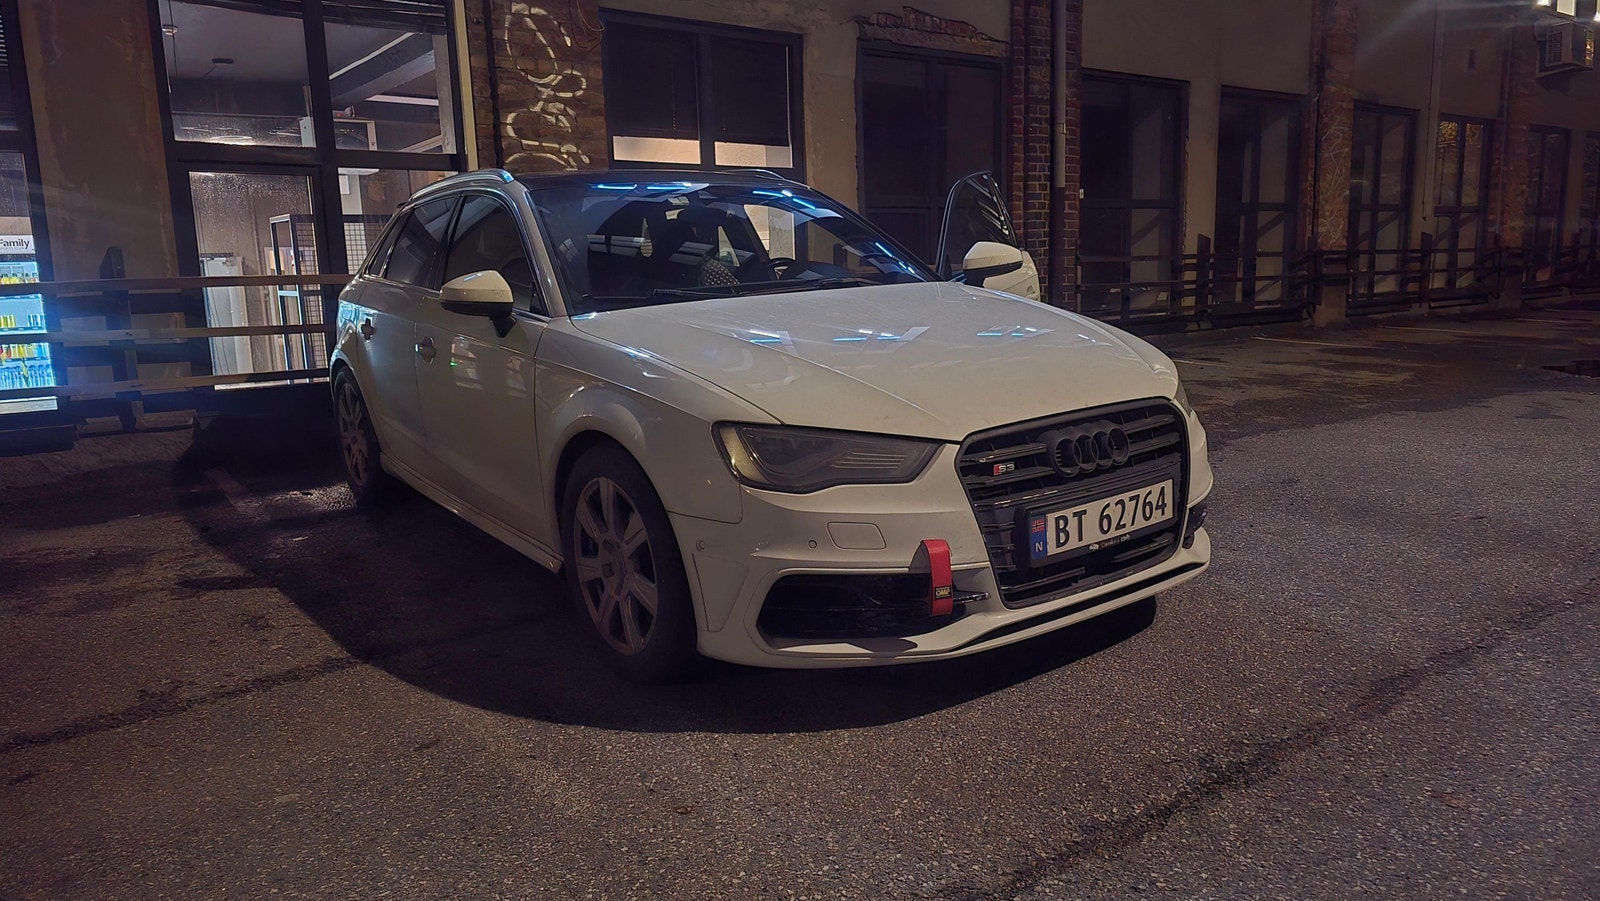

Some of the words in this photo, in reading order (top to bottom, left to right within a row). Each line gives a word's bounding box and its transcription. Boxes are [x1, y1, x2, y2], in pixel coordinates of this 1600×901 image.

[997, 463, 1015, 473] S3
[1054, 509, 1087, 549] BT
[1099, 486, 1167, 535] 62764
[1035, 541, 1043, 553] N
[935, 588, 951, 597] OMP
